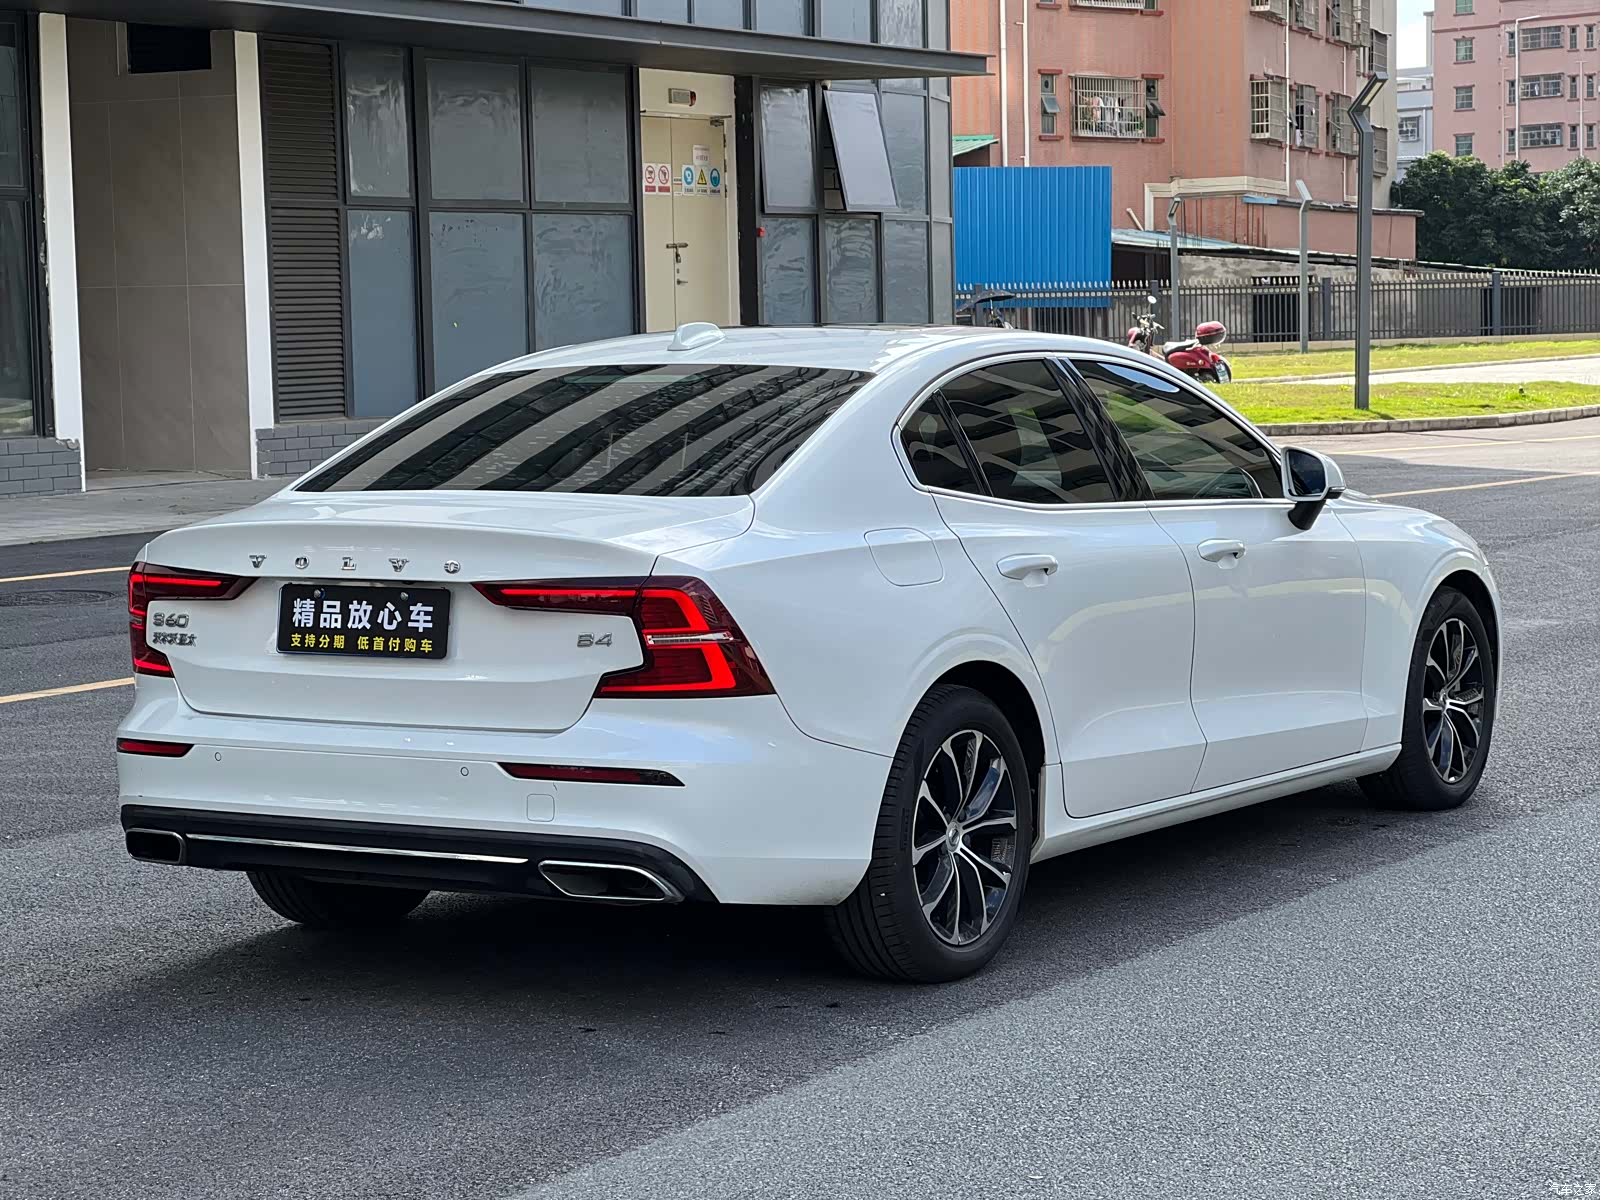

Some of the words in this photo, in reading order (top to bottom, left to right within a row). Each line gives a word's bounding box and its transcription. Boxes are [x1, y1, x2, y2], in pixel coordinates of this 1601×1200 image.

[249, 554, 461, 575] VOLVO
[153, 612, 189, 628] S60
[292, 598, 434, 633] 精品放心车
[290, 633, 345, 649] 支持分期
[357, 636, 433, 653] 低首付购车
[577, 632, 612, 648] B4
